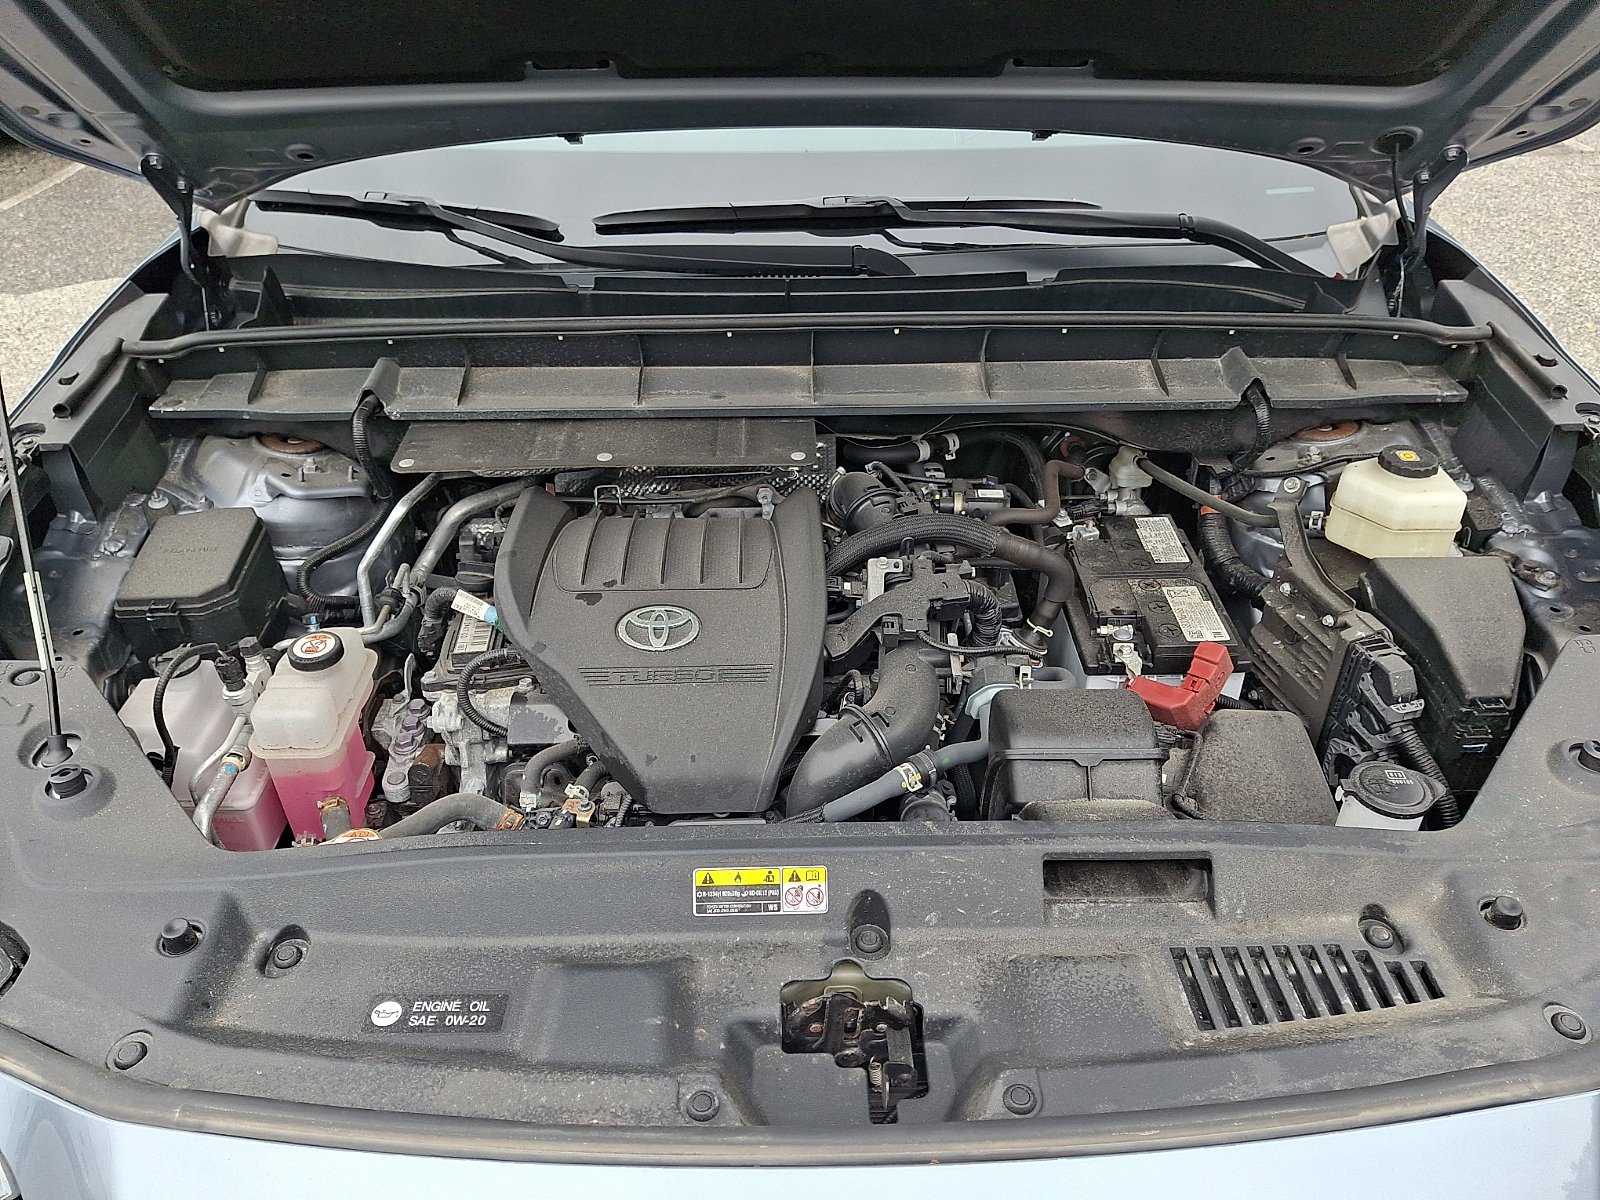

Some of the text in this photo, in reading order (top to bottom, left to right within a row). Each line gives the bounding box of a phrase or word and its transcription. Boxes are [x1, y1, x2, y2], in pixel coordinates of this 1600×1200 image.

[612, 669, 716, 683] TURBO
[412, 1001, 491, 1012] ENGINE OIL
[408, 1015, 487, 1026] SAE 0W-20
